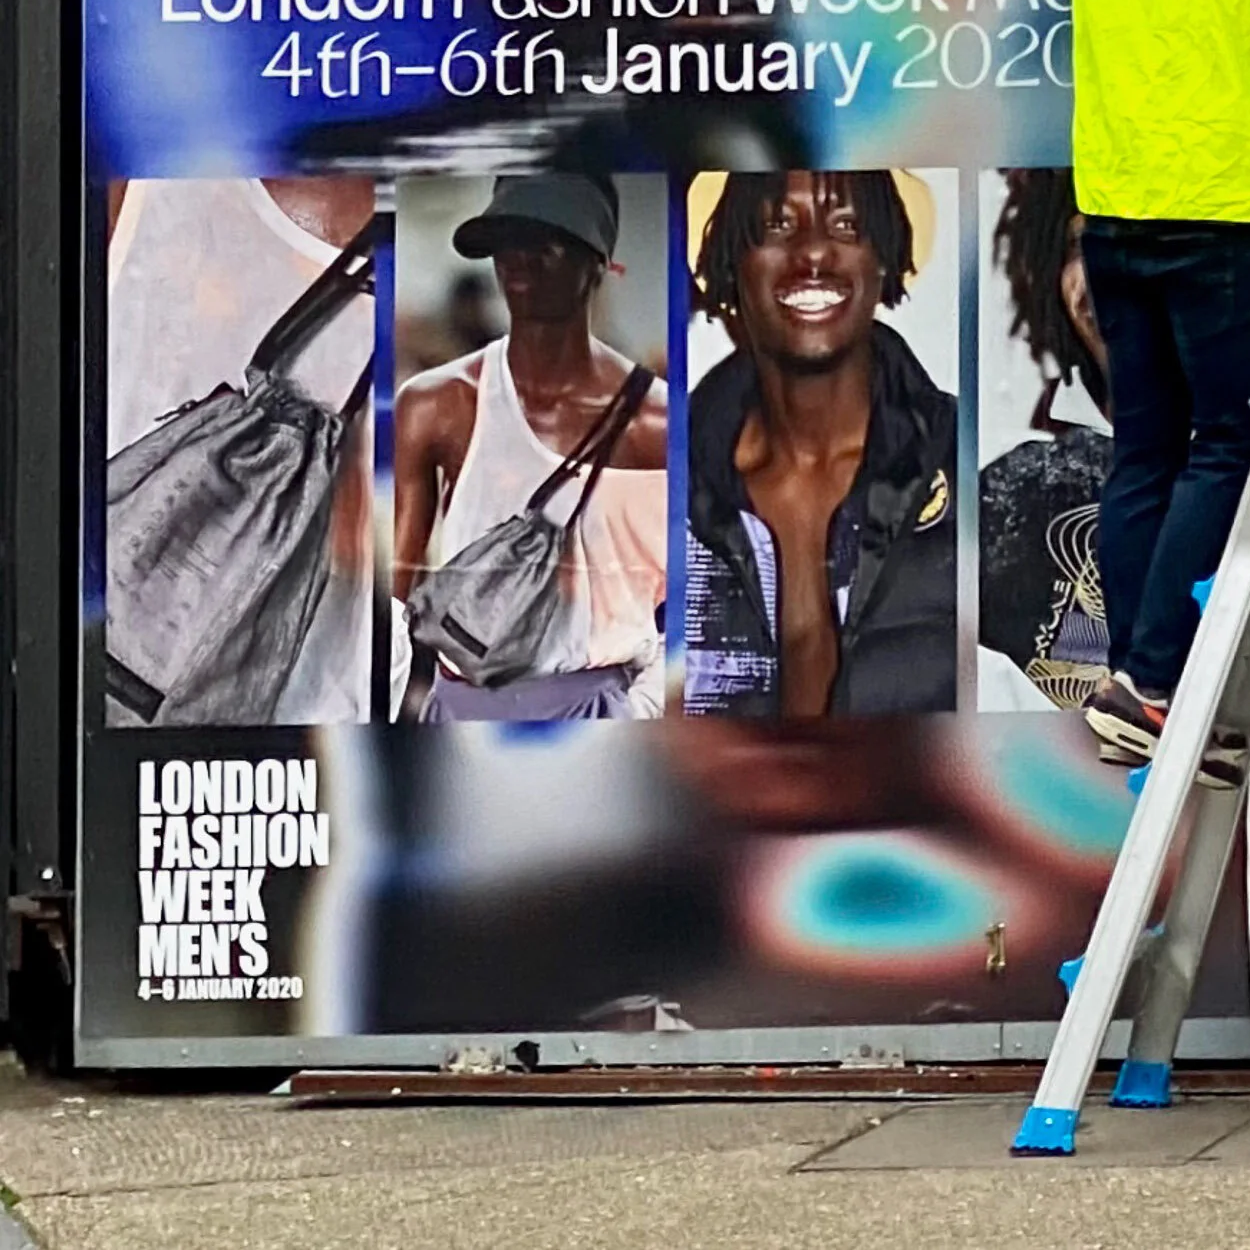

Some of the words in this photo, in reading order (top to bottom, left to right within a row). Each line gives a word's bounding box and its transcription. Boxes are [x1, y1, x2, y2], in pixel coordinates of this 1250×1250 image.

[581, 29, 872, 105] January
[138, 758, 317, 815] LONDON
[138, 813, 329, 869] FASHION
[138, 868, 267, 924] WEEK
[138, 922, 269, 978] MEN'S
[177, 977, 254, 999] JANUARY
[256, 976, 304, 999] 2020
